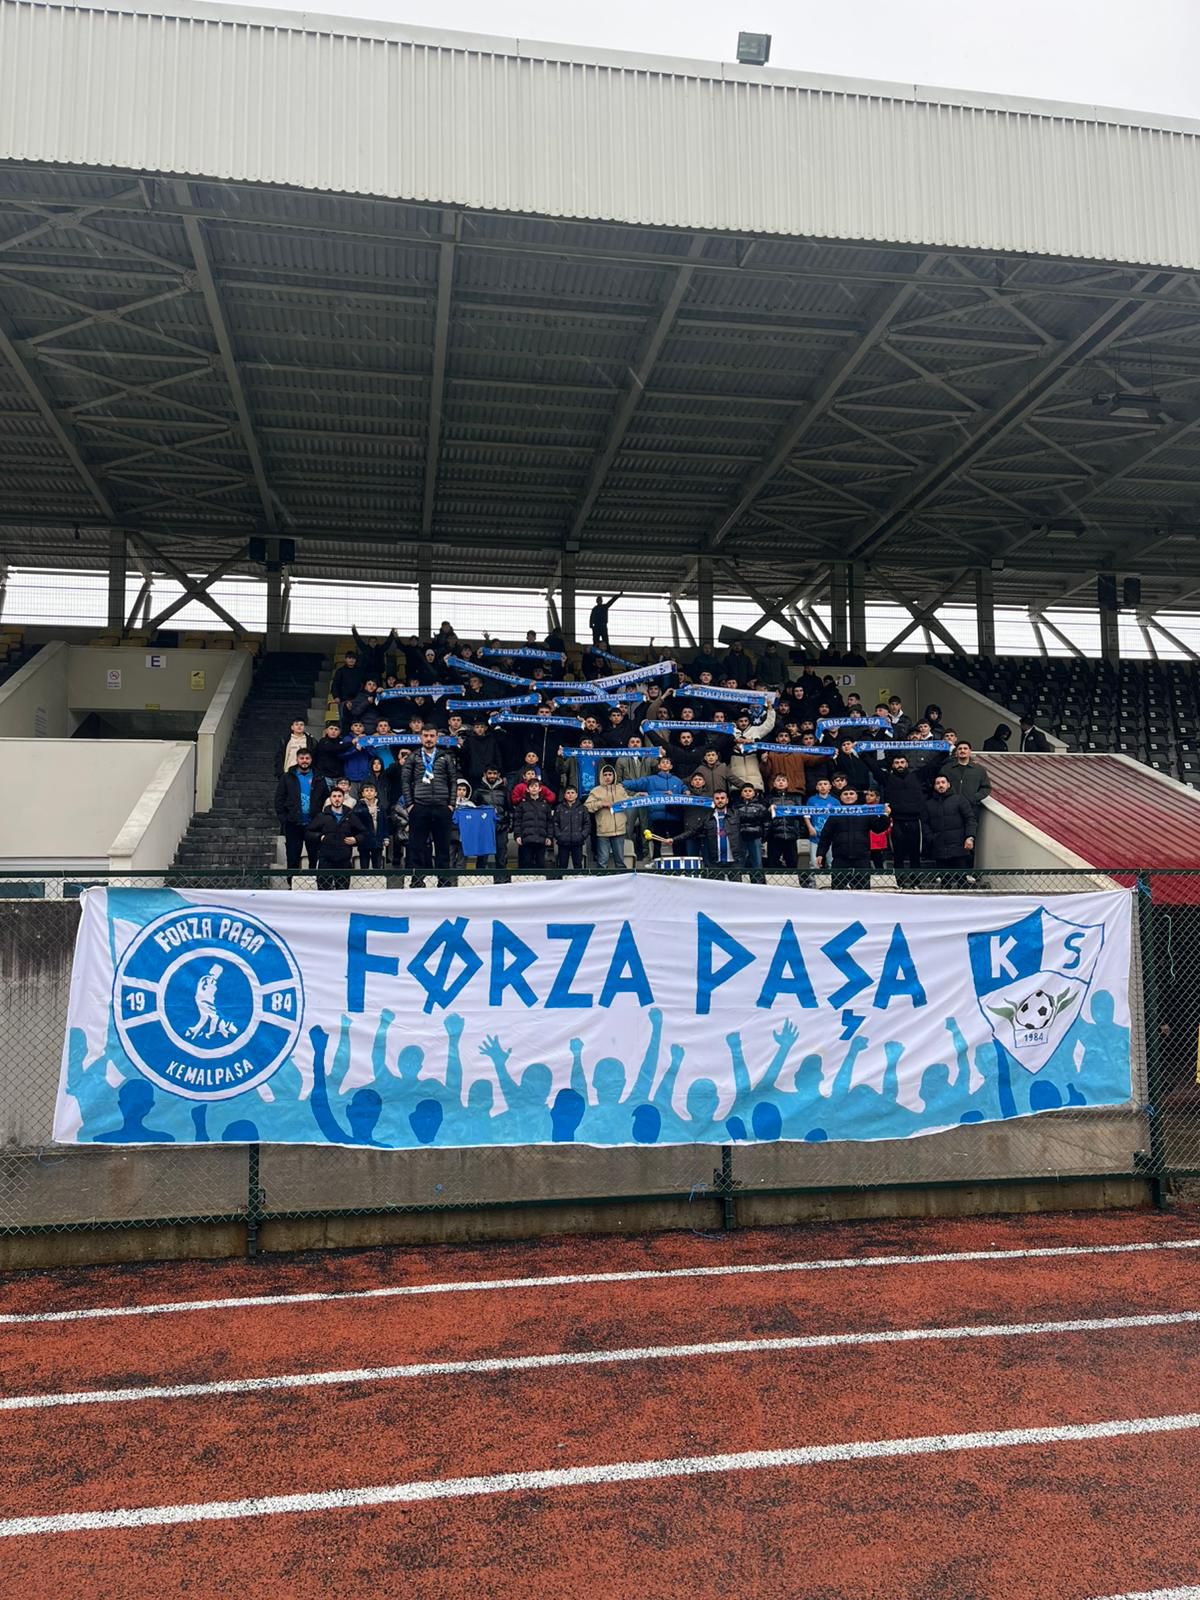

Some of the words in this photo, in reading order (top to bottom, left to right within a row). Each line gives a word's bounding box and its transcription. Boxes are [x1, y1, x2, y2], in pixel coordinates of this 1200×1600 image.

[151, 655, 161, 667] E
[842, 675, 852, 686] D
[154, 917, 212, 953] FORZA
[219, 918, 266, 954] PAŞA
[990, 935, 1019, 980] K
[1062, 932, 1085, 969] S
[695, 911, 928, 1041] PAŞA
[126, 991, 146, 1011] 19
[271, 992, 292, 1012] 84
[1023, 1032, 1044, 1042] 1984
